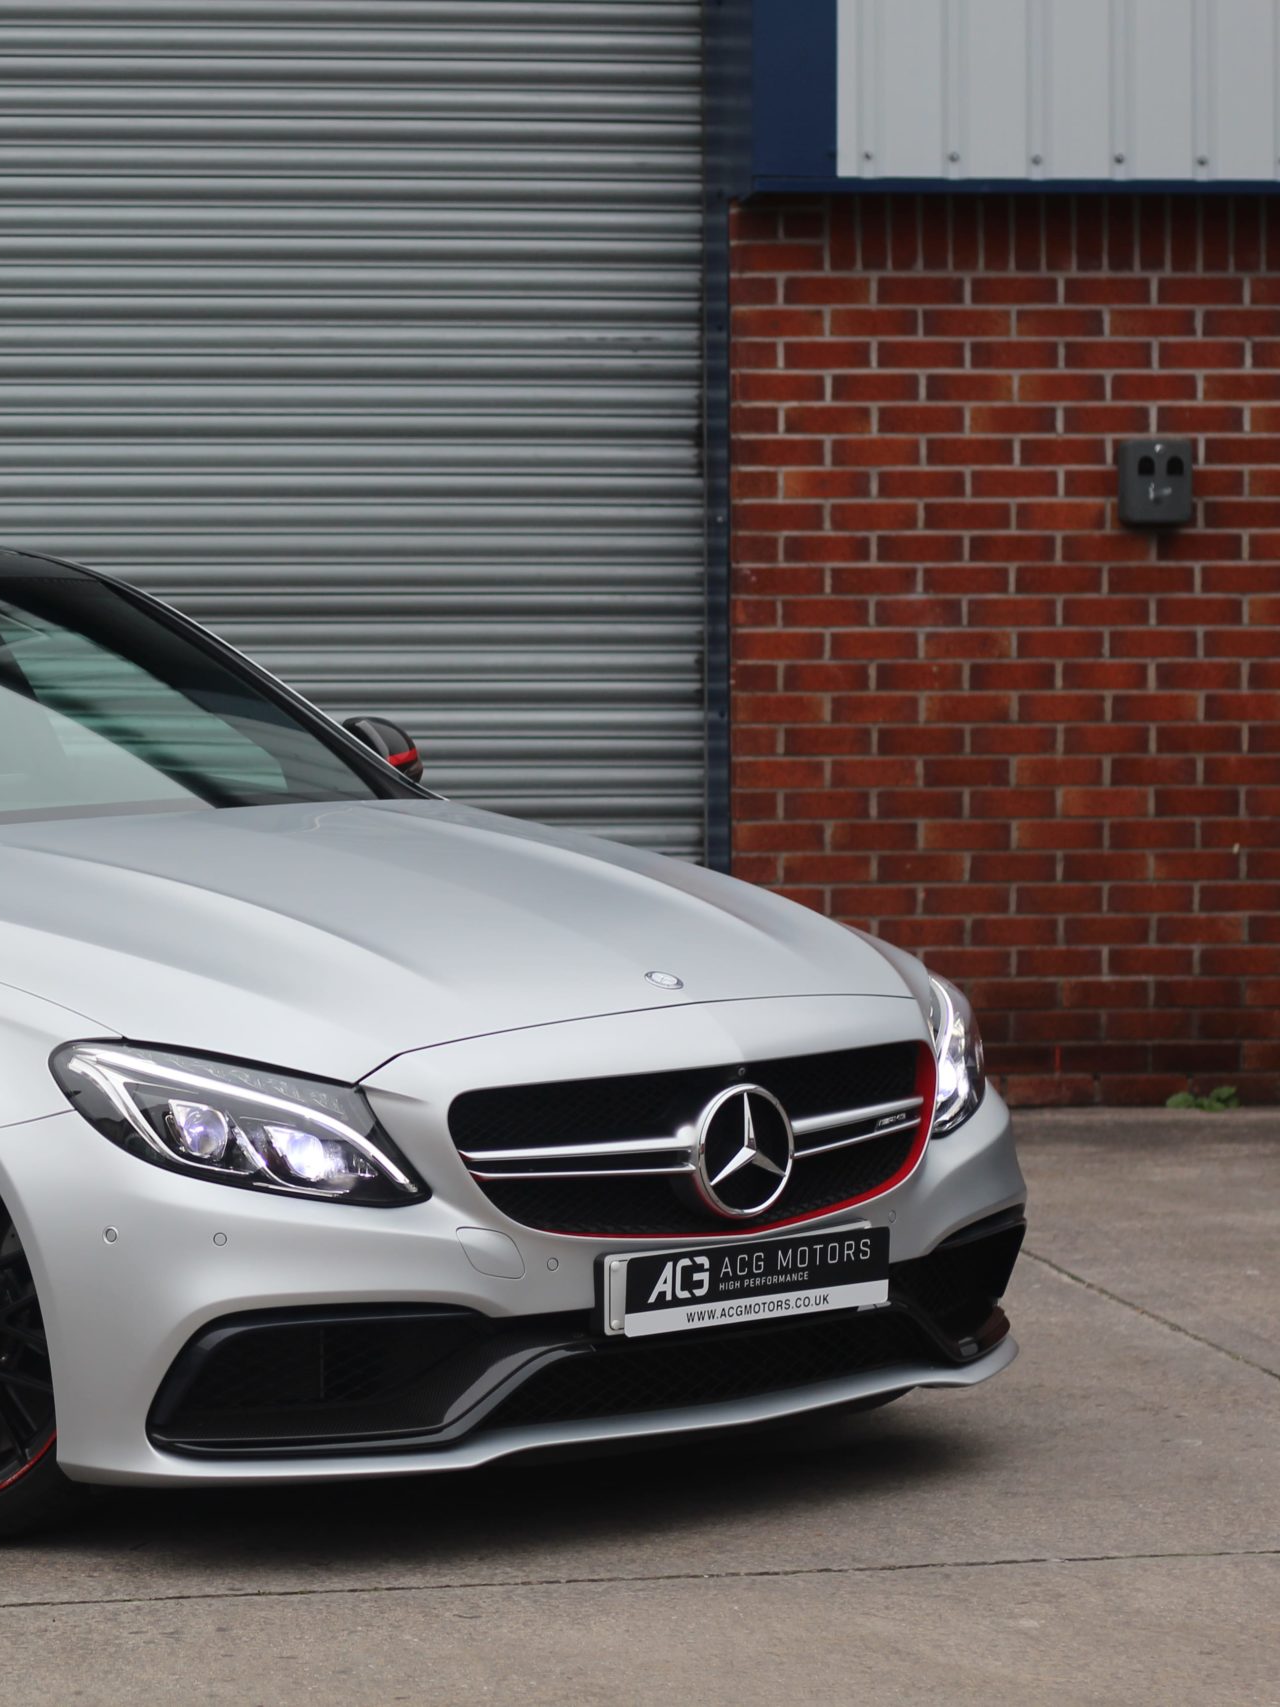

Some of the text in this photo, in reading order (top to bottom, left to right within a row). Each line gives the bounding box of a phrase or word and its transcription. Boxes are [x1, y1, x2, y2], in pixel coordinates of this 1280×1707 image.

[720, 1239, 871, 1277] ACG MOTORS
[648, 1255, 710, 1303] ACG
[719, 1271, 809, 1291] HIGH PERFORMANCE
[686, 1294, 830, 1323] WWW.ACGMOTORS.CO.UK
